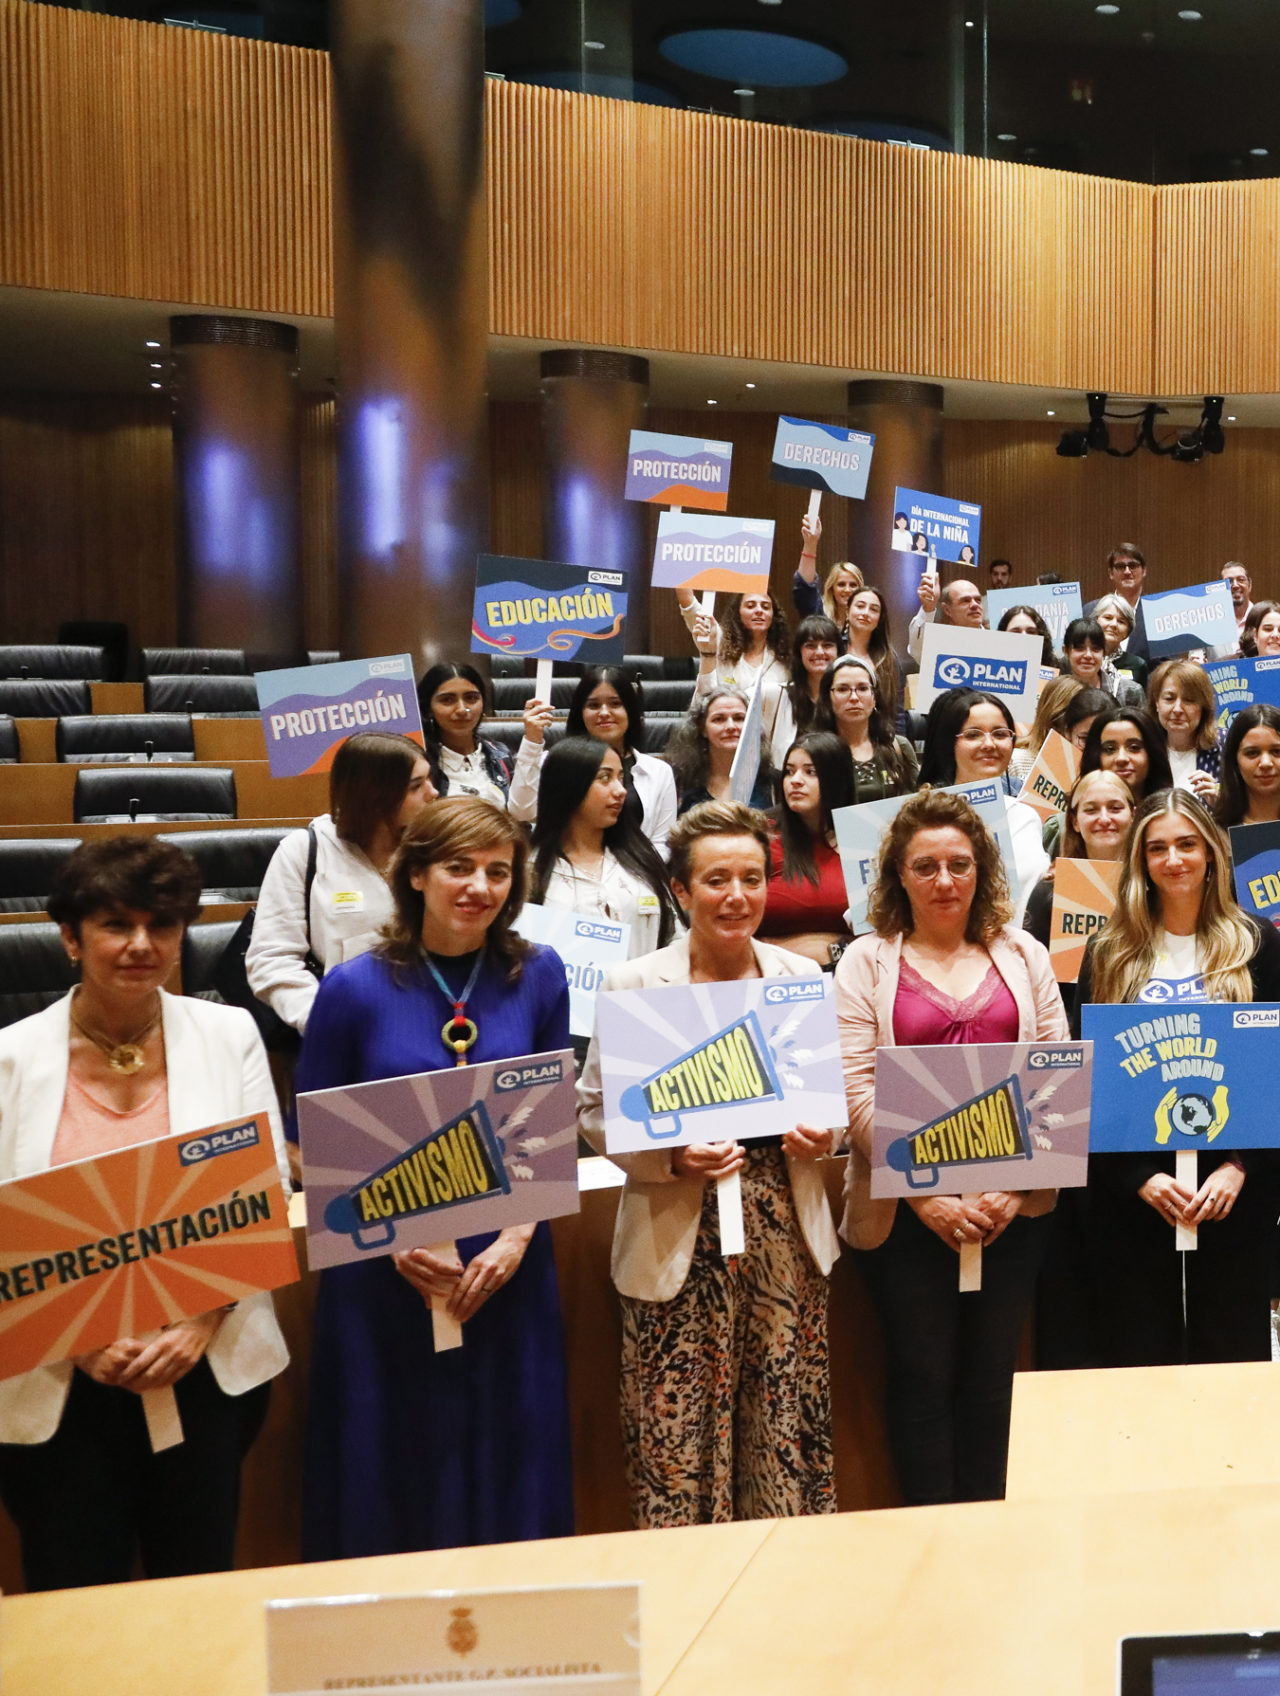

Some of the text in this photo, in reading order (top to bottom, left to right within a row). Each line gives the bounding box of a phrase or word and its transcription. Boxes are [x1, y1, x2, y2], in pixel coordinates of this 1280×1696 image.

[783, 442, 860, 471] DERECHOS
[632, 459, 722, 483] PROTECCIÓN
[909, 518, 969, 544] DE LA NIÑA
[660, 541, 762, 564] PROTECCIÓN
[485, 587, 615, 628] EDUCACIÓN
[1154, 602, 1225, 634] DERECHOS
[973, 663, 1023, 683] PLAN
[972, 680, 1021, 692] INTERNATIONAL
[1213, 678, 1248, 694] WORLD
[270, 689, 407, 741] PROTECCIÓN
[970, 787, 996, 800] PLAN
[594, 926, 621, 939] PLAN
[789, 983, 823, 997] PLAN
[1252, 1013, 1278, 1021] PLAN
[1114, 1013, 1201, 1054] TURNING
[1050, 1052, 1082, 1063] PLAN
[1120, 1036, 1218, 1078] THE WORLD
[522, 1064, 560, 1080] PLAN
[652, 1026, 765, 1113] ACTIVISMO
[1161, 1059, 1225, 1083] AROUND
[211, 1126, 255, 1148] PLAN
[915, 1088, 1016, 1165] ACTIVISMO
[359, 1119, 489, 1222] ACTIVISMO
